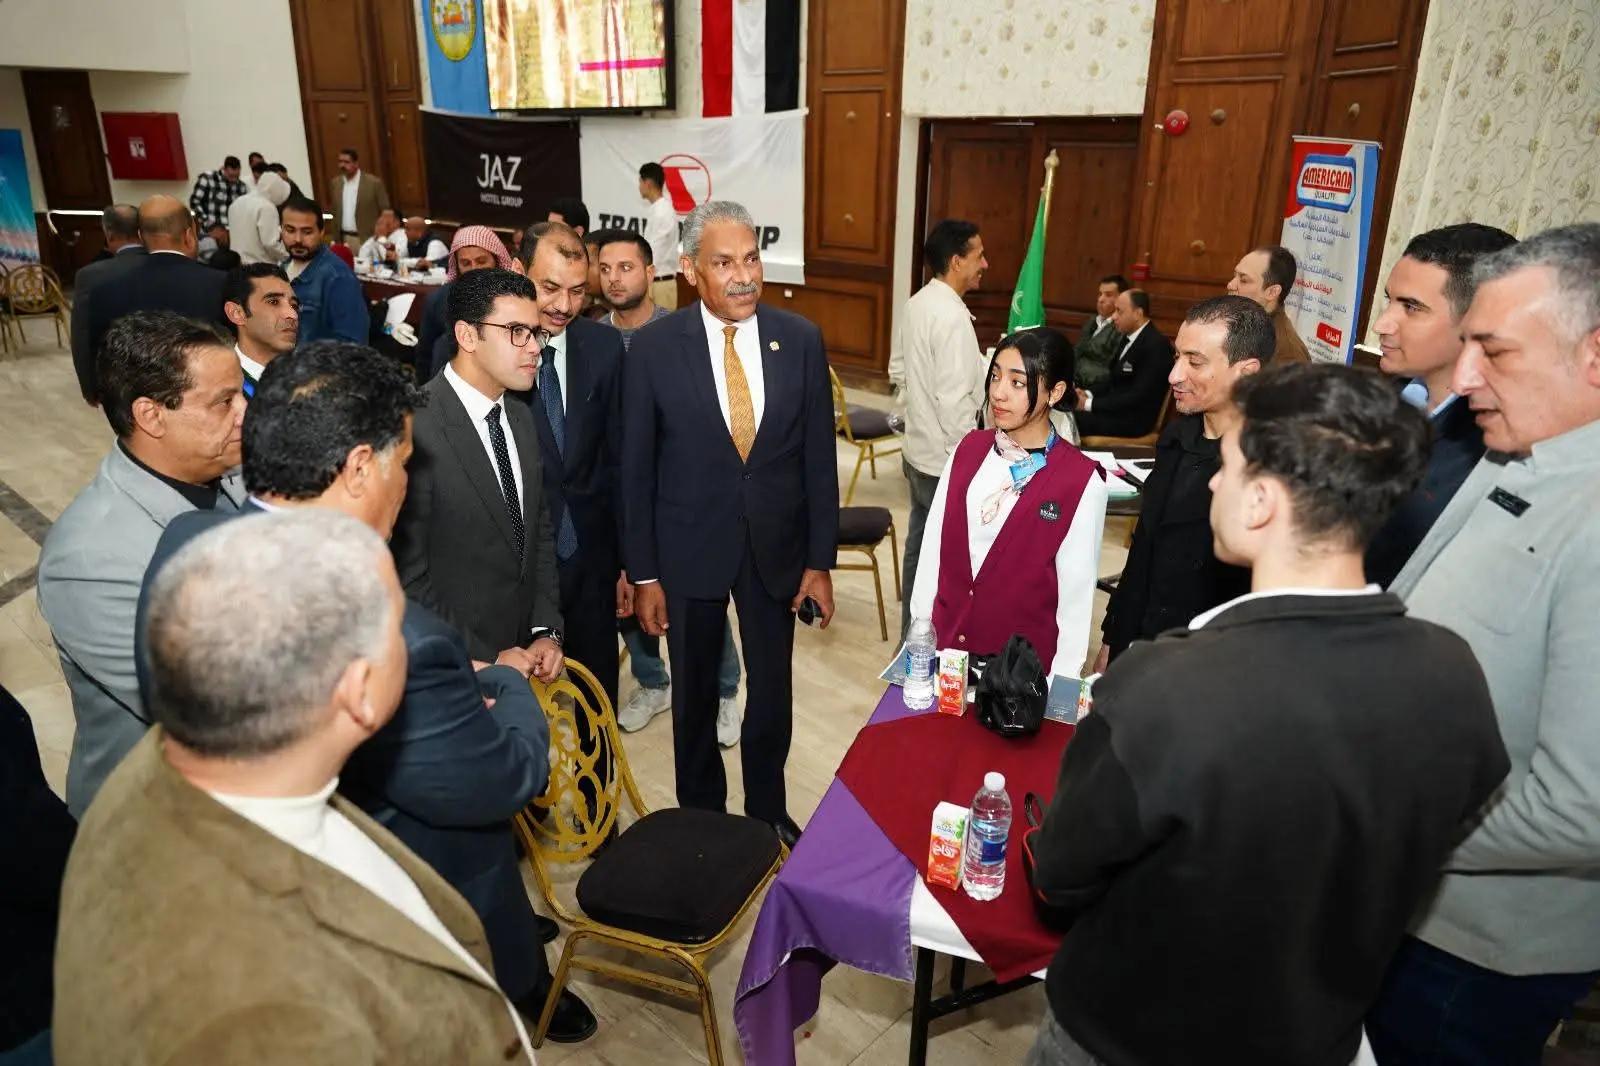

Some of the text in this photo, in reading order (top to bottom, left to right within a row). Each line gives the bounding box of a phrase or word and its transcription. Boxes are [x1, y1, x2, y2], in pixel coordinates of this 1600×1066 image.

[476, 153, 522, 191] JAZ
[480, 193, 524, 208] HOTEL GROUP
[1314, 191, 1337, 201] QUALITY
